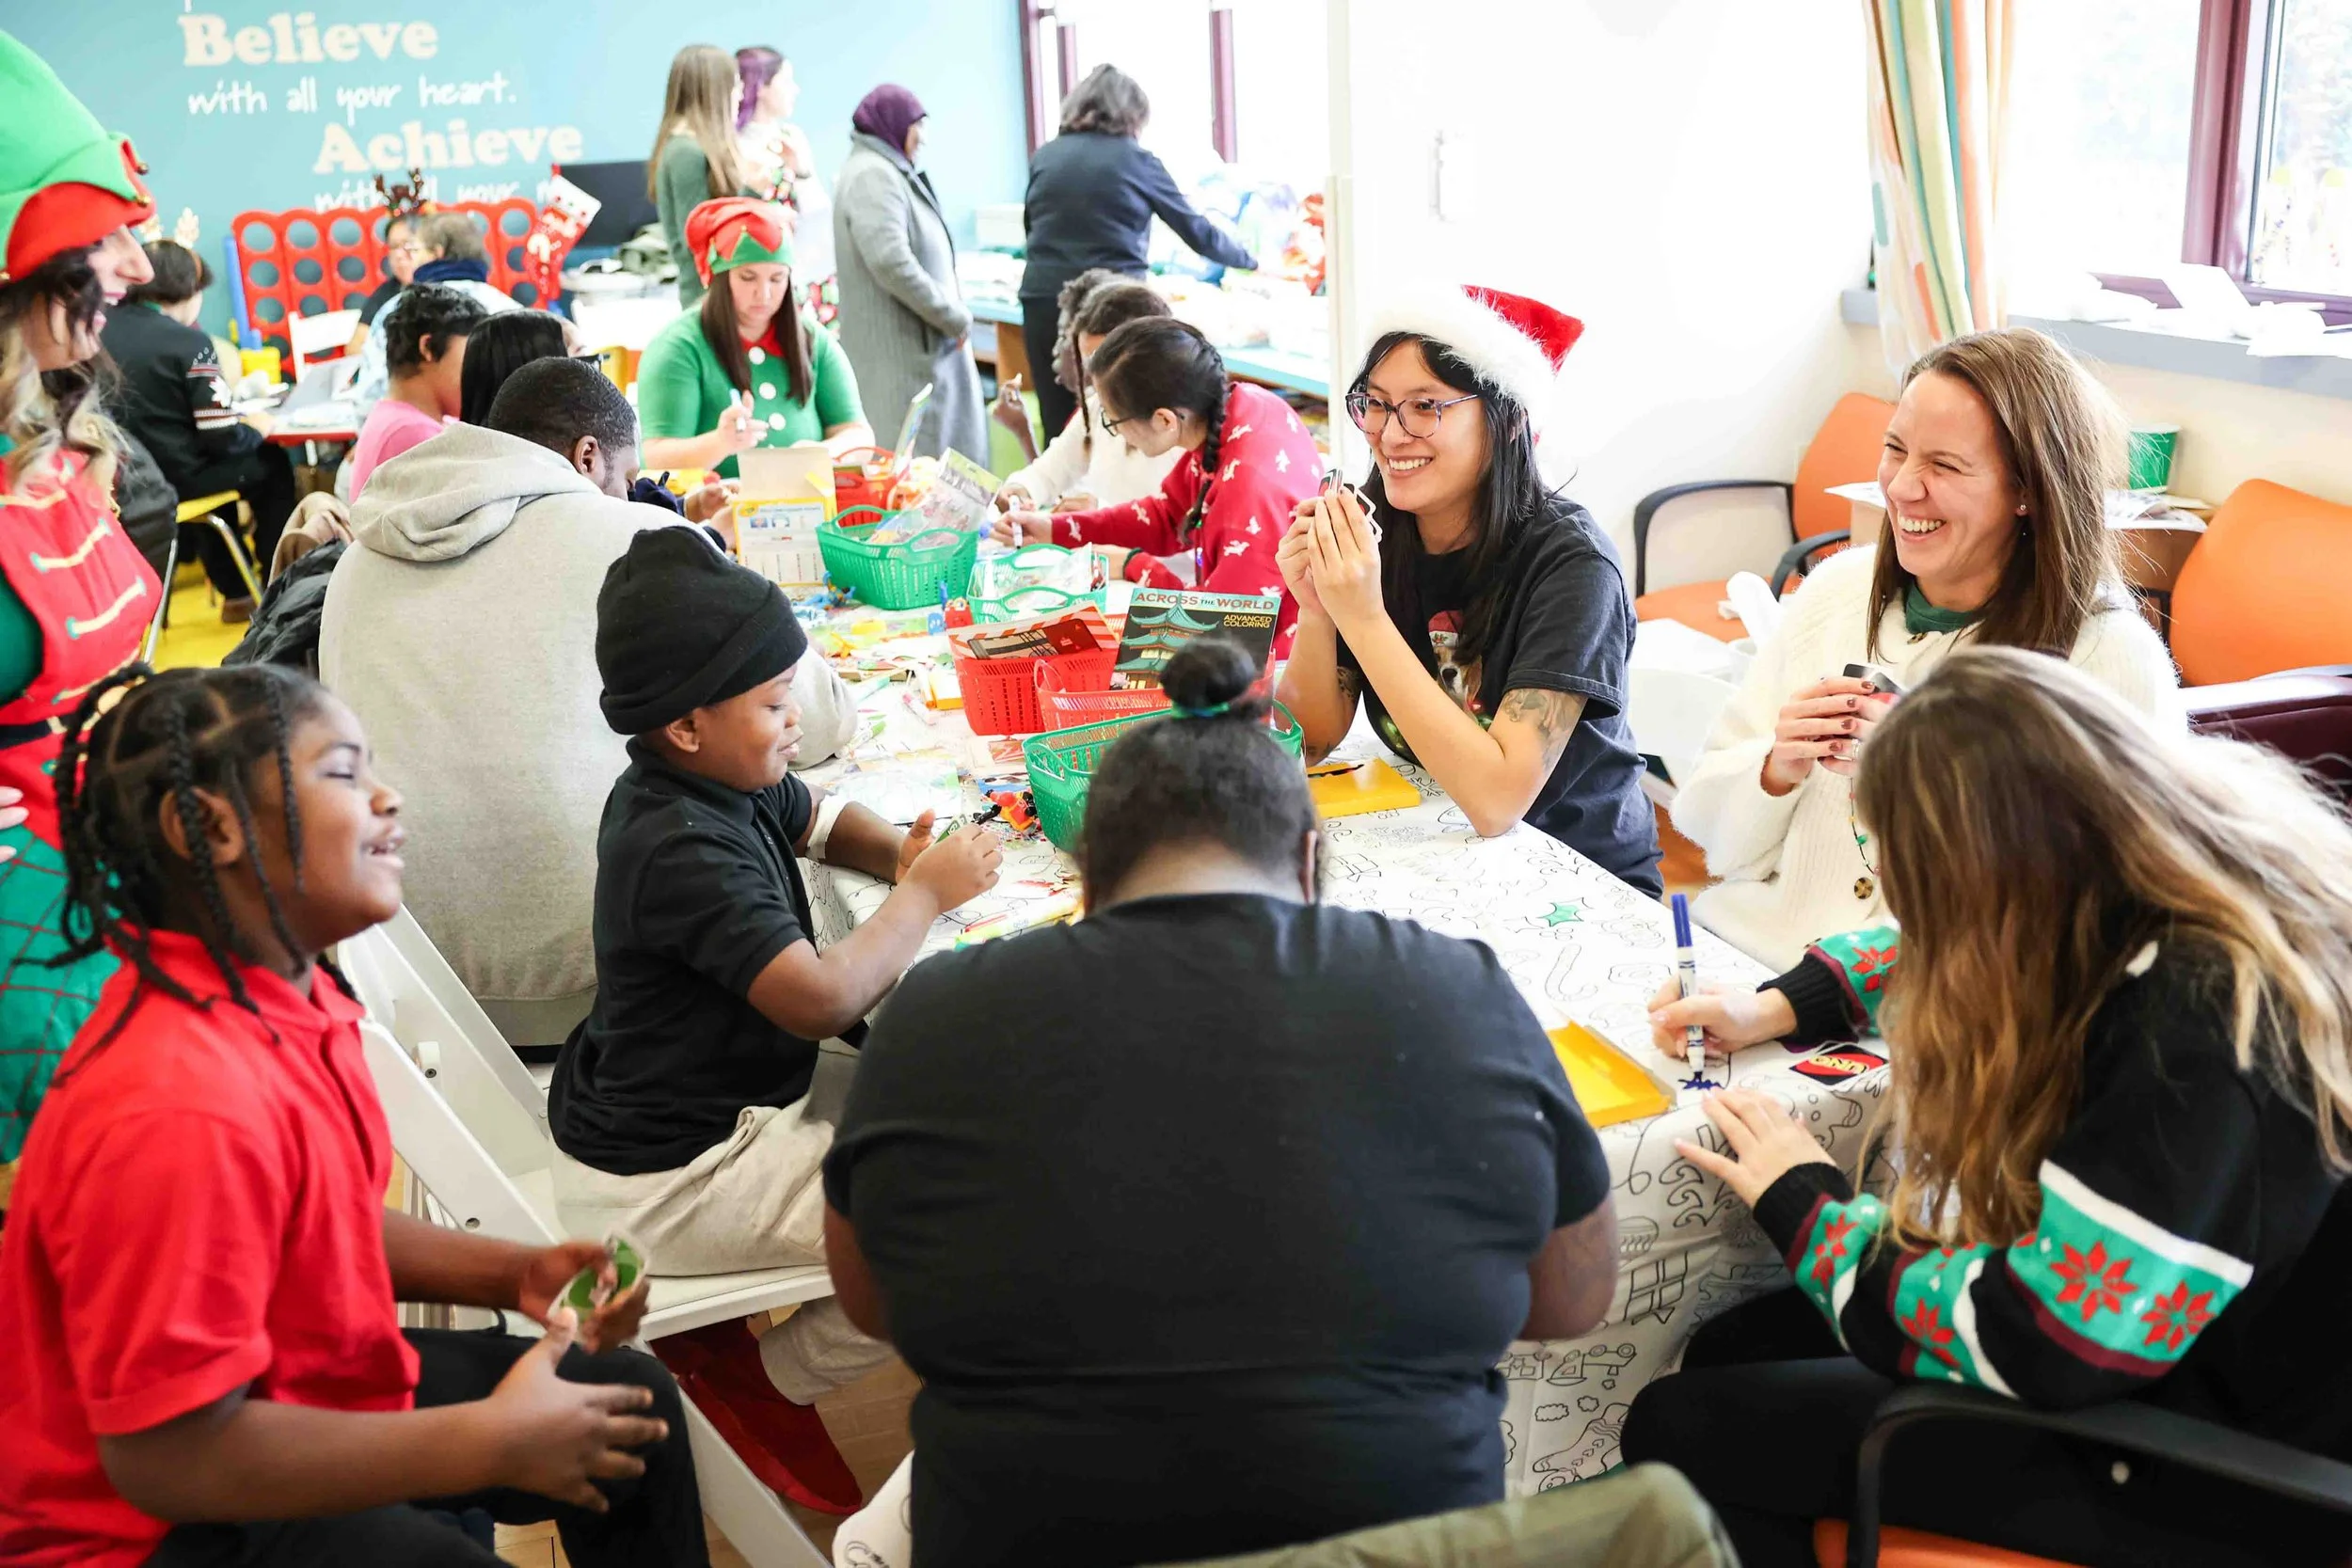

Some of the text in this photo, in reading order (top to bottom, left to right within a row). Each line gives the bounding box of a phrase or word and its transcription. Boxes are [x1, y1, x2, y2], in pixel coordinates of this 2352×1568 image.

[177, 12, 438, 67] Believe
[187, 71, 516, 128] with all your heart.
[312, 119, 583, 174] Achieve
[1136, 593, 1199, 605] ACROSS
[1216, 598, 1275, 610] WORLD
[1224, 614, 1272, 623] ADVANCED
[1224, 620, 1270, 628] COLORING
[1810, 1054, 1868, 1074] UNO
